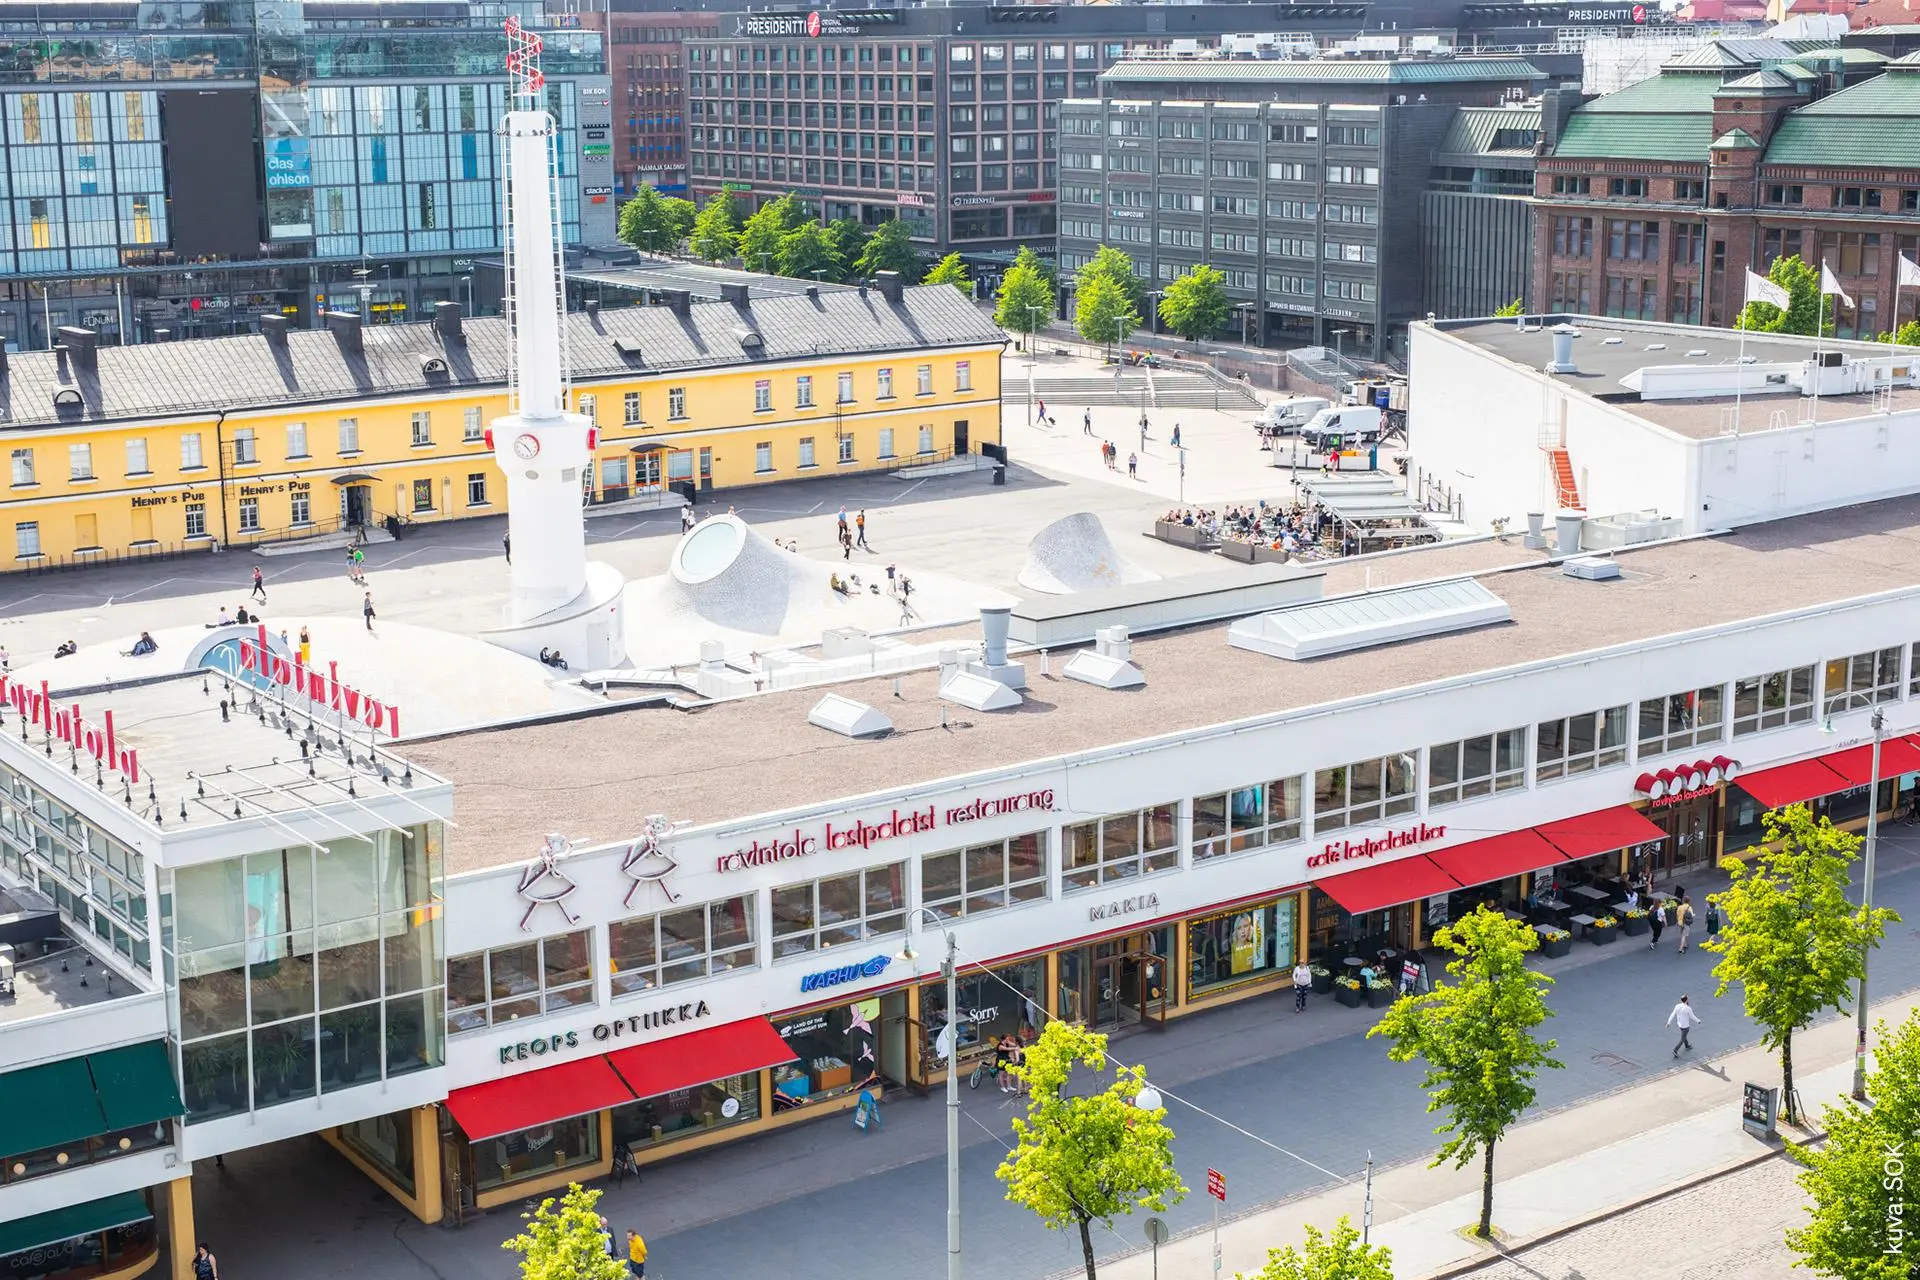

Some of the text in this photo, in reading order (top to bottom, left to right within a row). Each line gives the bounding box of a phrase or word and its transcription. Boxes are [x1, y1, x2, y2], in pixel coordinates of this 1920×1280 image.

[1568, 9, 1631, 20] PRESIDENTTI
[747, 20, 807, 35] PRESIDENTTI
[267, 157, 294, 170] clas
[269, 172, 310, 186] ohlson
[585, 187, 612, 195] stadium
[454, 258, 472, 266] VOLT
[715, 787, 1055, 874] ravintola lasipalatsi restaurang
[1306, 822, 1447, 869] café lasipalatsi bar
[1089, 891, 1161, 922] MAKIA
[800, 966, 862, 993] KARHU
[969, 1005, 1000, 1023] Sorry.
[793, 1020, 807, 1030] LAND
[806, 1019, 814, 1027] OF
[793, 1025, 818, 1036] MIDNIGHT
[817, 1022, 828, 1030] SUN
[498, 999, 712, 1065] KEOPS OPTIIKKA
